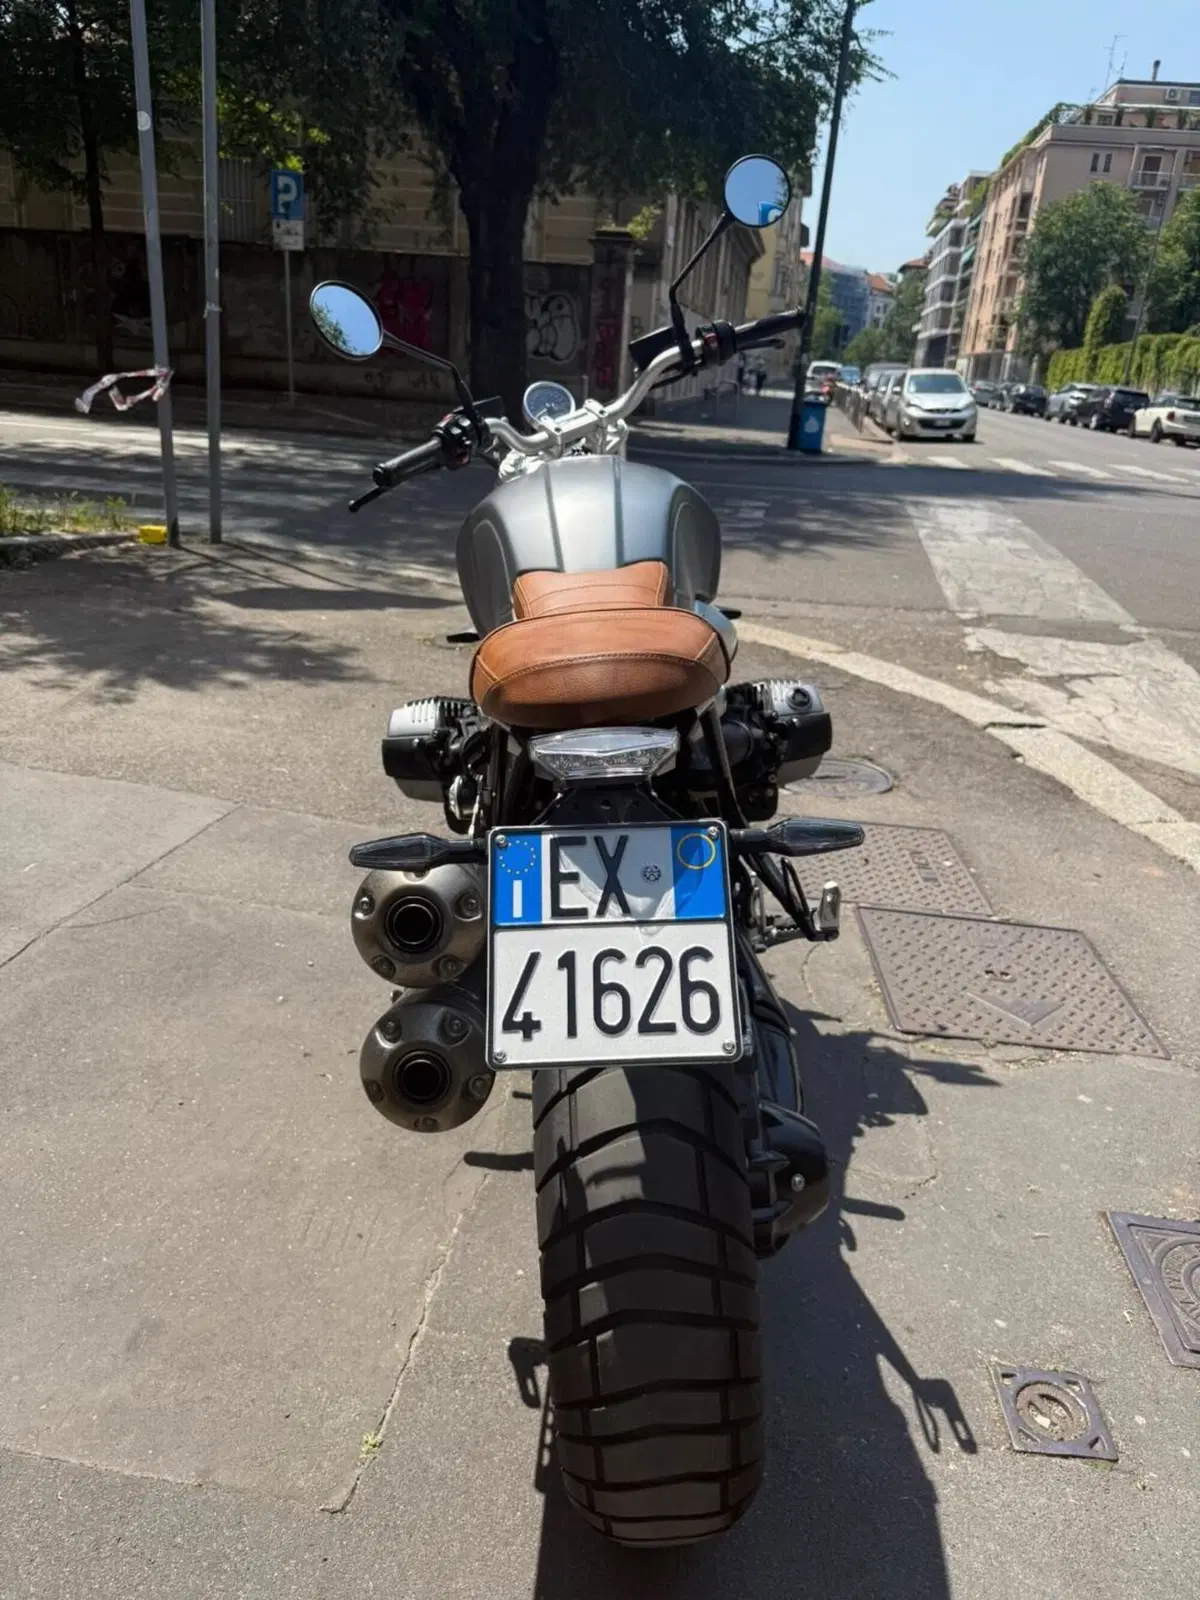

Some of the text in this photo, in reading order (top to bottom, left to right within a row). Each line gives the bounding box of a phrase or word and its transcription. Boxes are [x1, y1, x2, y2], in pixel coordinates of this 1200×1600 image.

[276, 175, 298, 214] P
[550, 834, 632, 918] EX
[502, 945, 721, 1041] 41626
